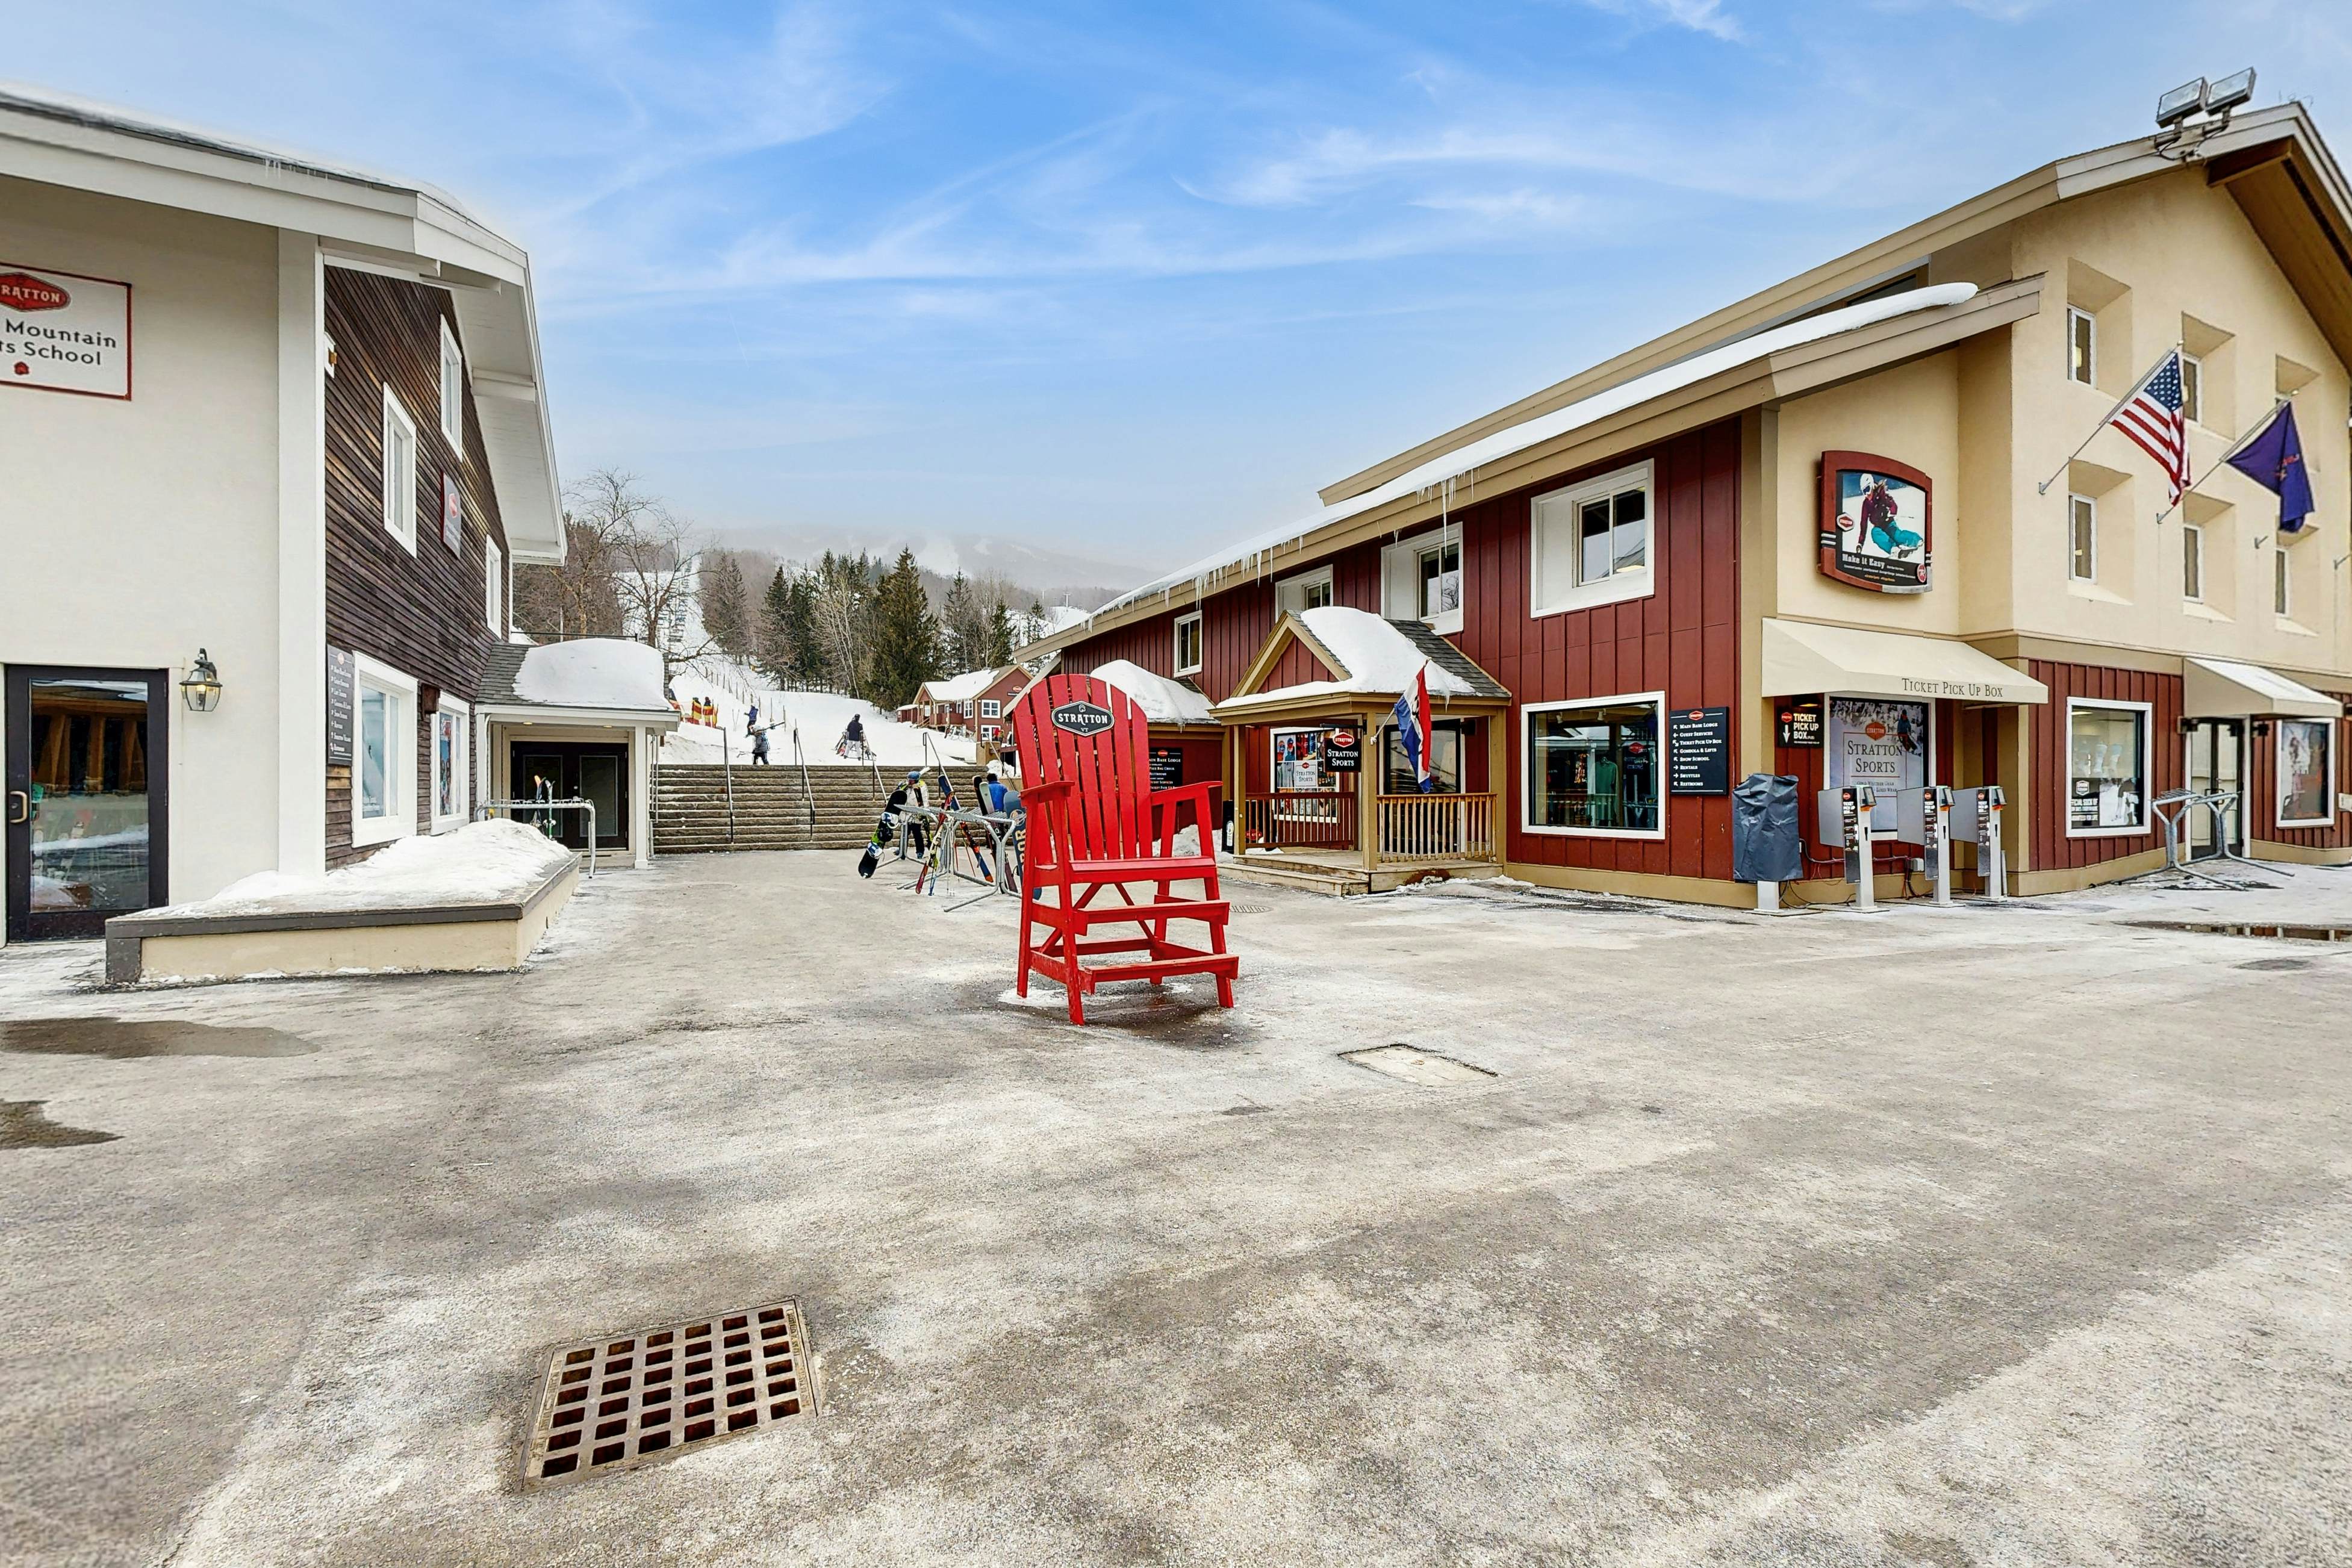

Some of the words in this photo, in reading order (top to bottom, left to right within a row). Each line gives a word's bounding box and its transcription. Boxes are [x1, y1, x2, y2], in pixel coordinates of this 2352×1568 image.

[6, 318, 116, 348] Mountain
[24, 342, 101, 365] School
[1842, 553, 1860, 564] Make
[1869, 558, 1885, 569] Easy
[1902, 678, 1939, 693] TICKET
[1943, 682, 1965, 695] PICK
[1968, 684, 1980, 696] UP
[1985, 685, 2003, 697] BOX
[1058, 713, 1107, 726] STRATTON
[1793, 713, 1817, 722] TICKET
[1847, 741, 1902, 756] STRATTON
[1856, 758, 1895, 773] SPORTS
